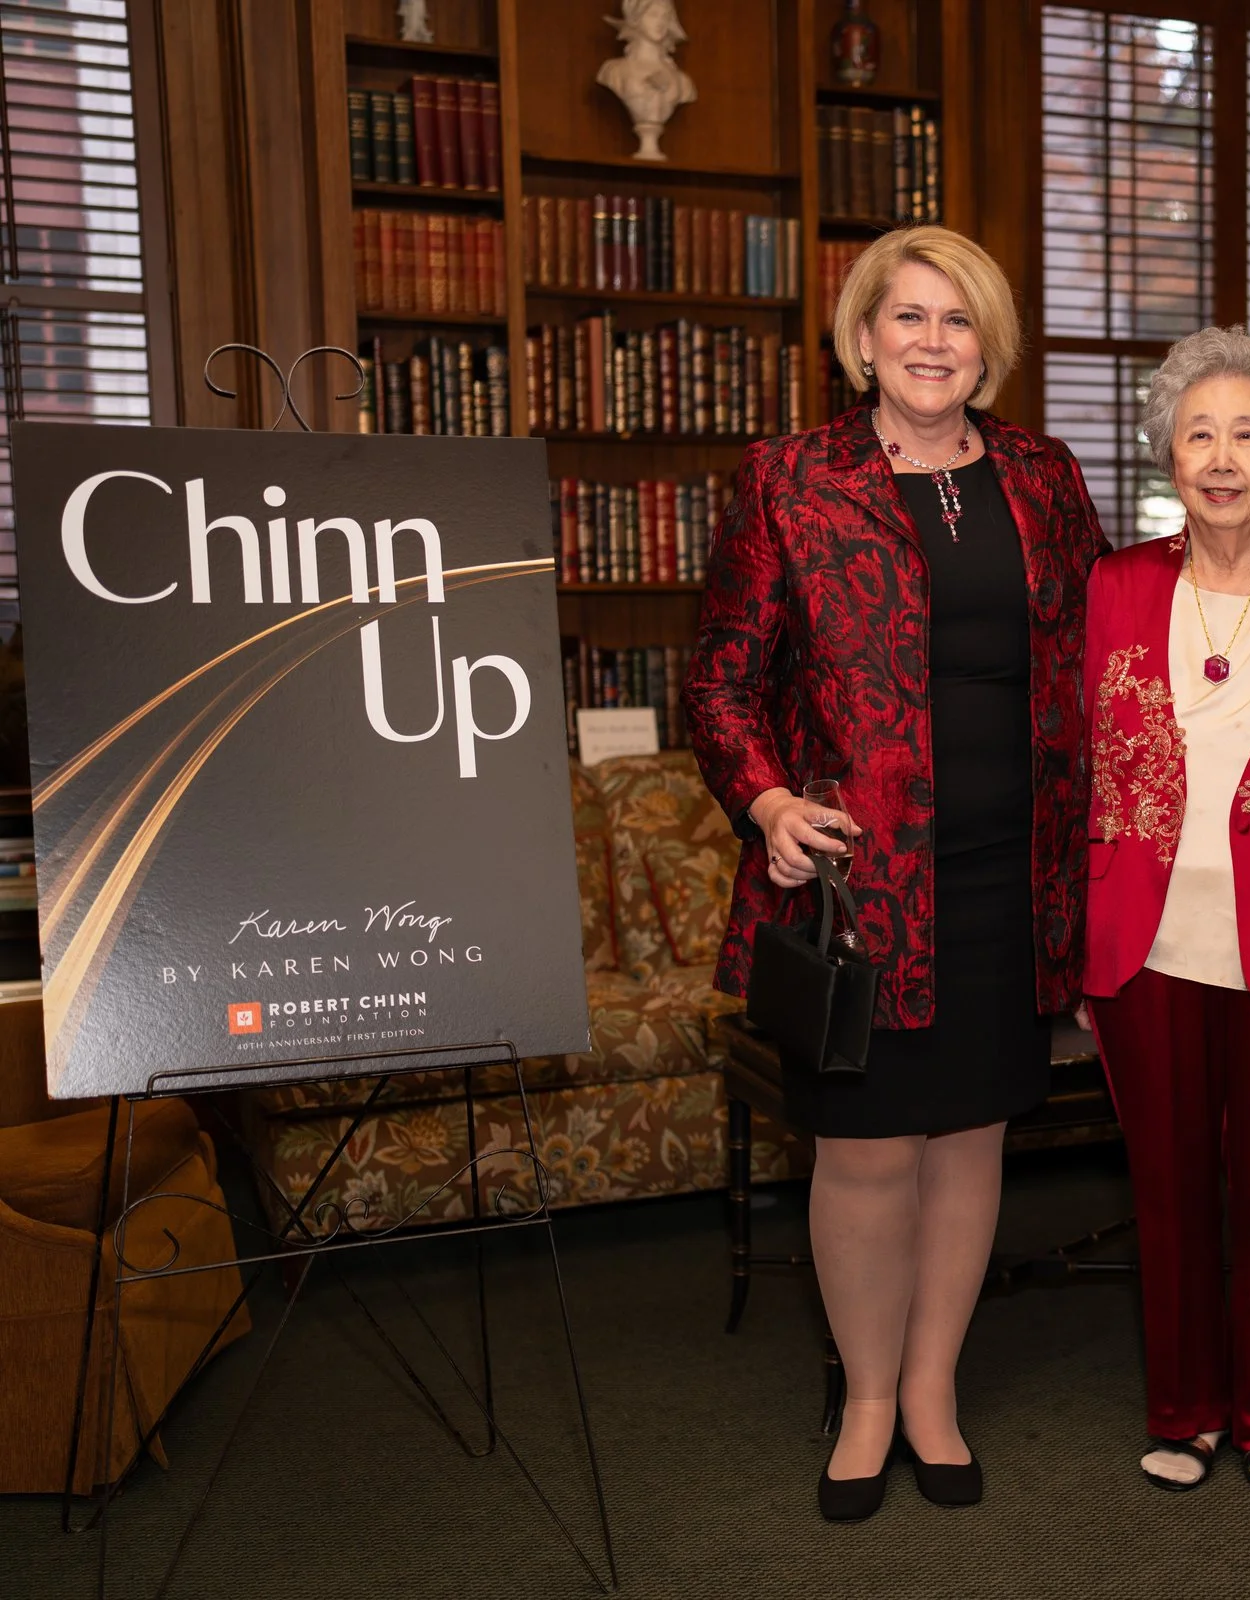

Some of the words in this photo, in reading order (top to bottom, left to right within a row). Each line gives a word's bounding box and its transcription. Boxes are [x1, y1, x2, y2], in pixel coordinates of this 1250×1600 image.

[60, 469, 446, 604] Chinn
[360, 615, 531, 778] Up
[228, 909, 347, 944] Karen
[163, 965, 202, 984] BY
[232, 955, 350, 980] KAREN
[378, 946, 483, 969] WONG
[269, 998, 350, 1016] ROBERT
[359, 992, 427, 1009] CHINN
[270, 1008, 427, 1028] FOUNDATION
[236, 1042, 264, 1051] 40TH
[268, 1035, 343, 1049] ANNIVERSARY
[347, 1032, 377, 1042] FIRST
[381, 1028, 425, 1039] EDITION
